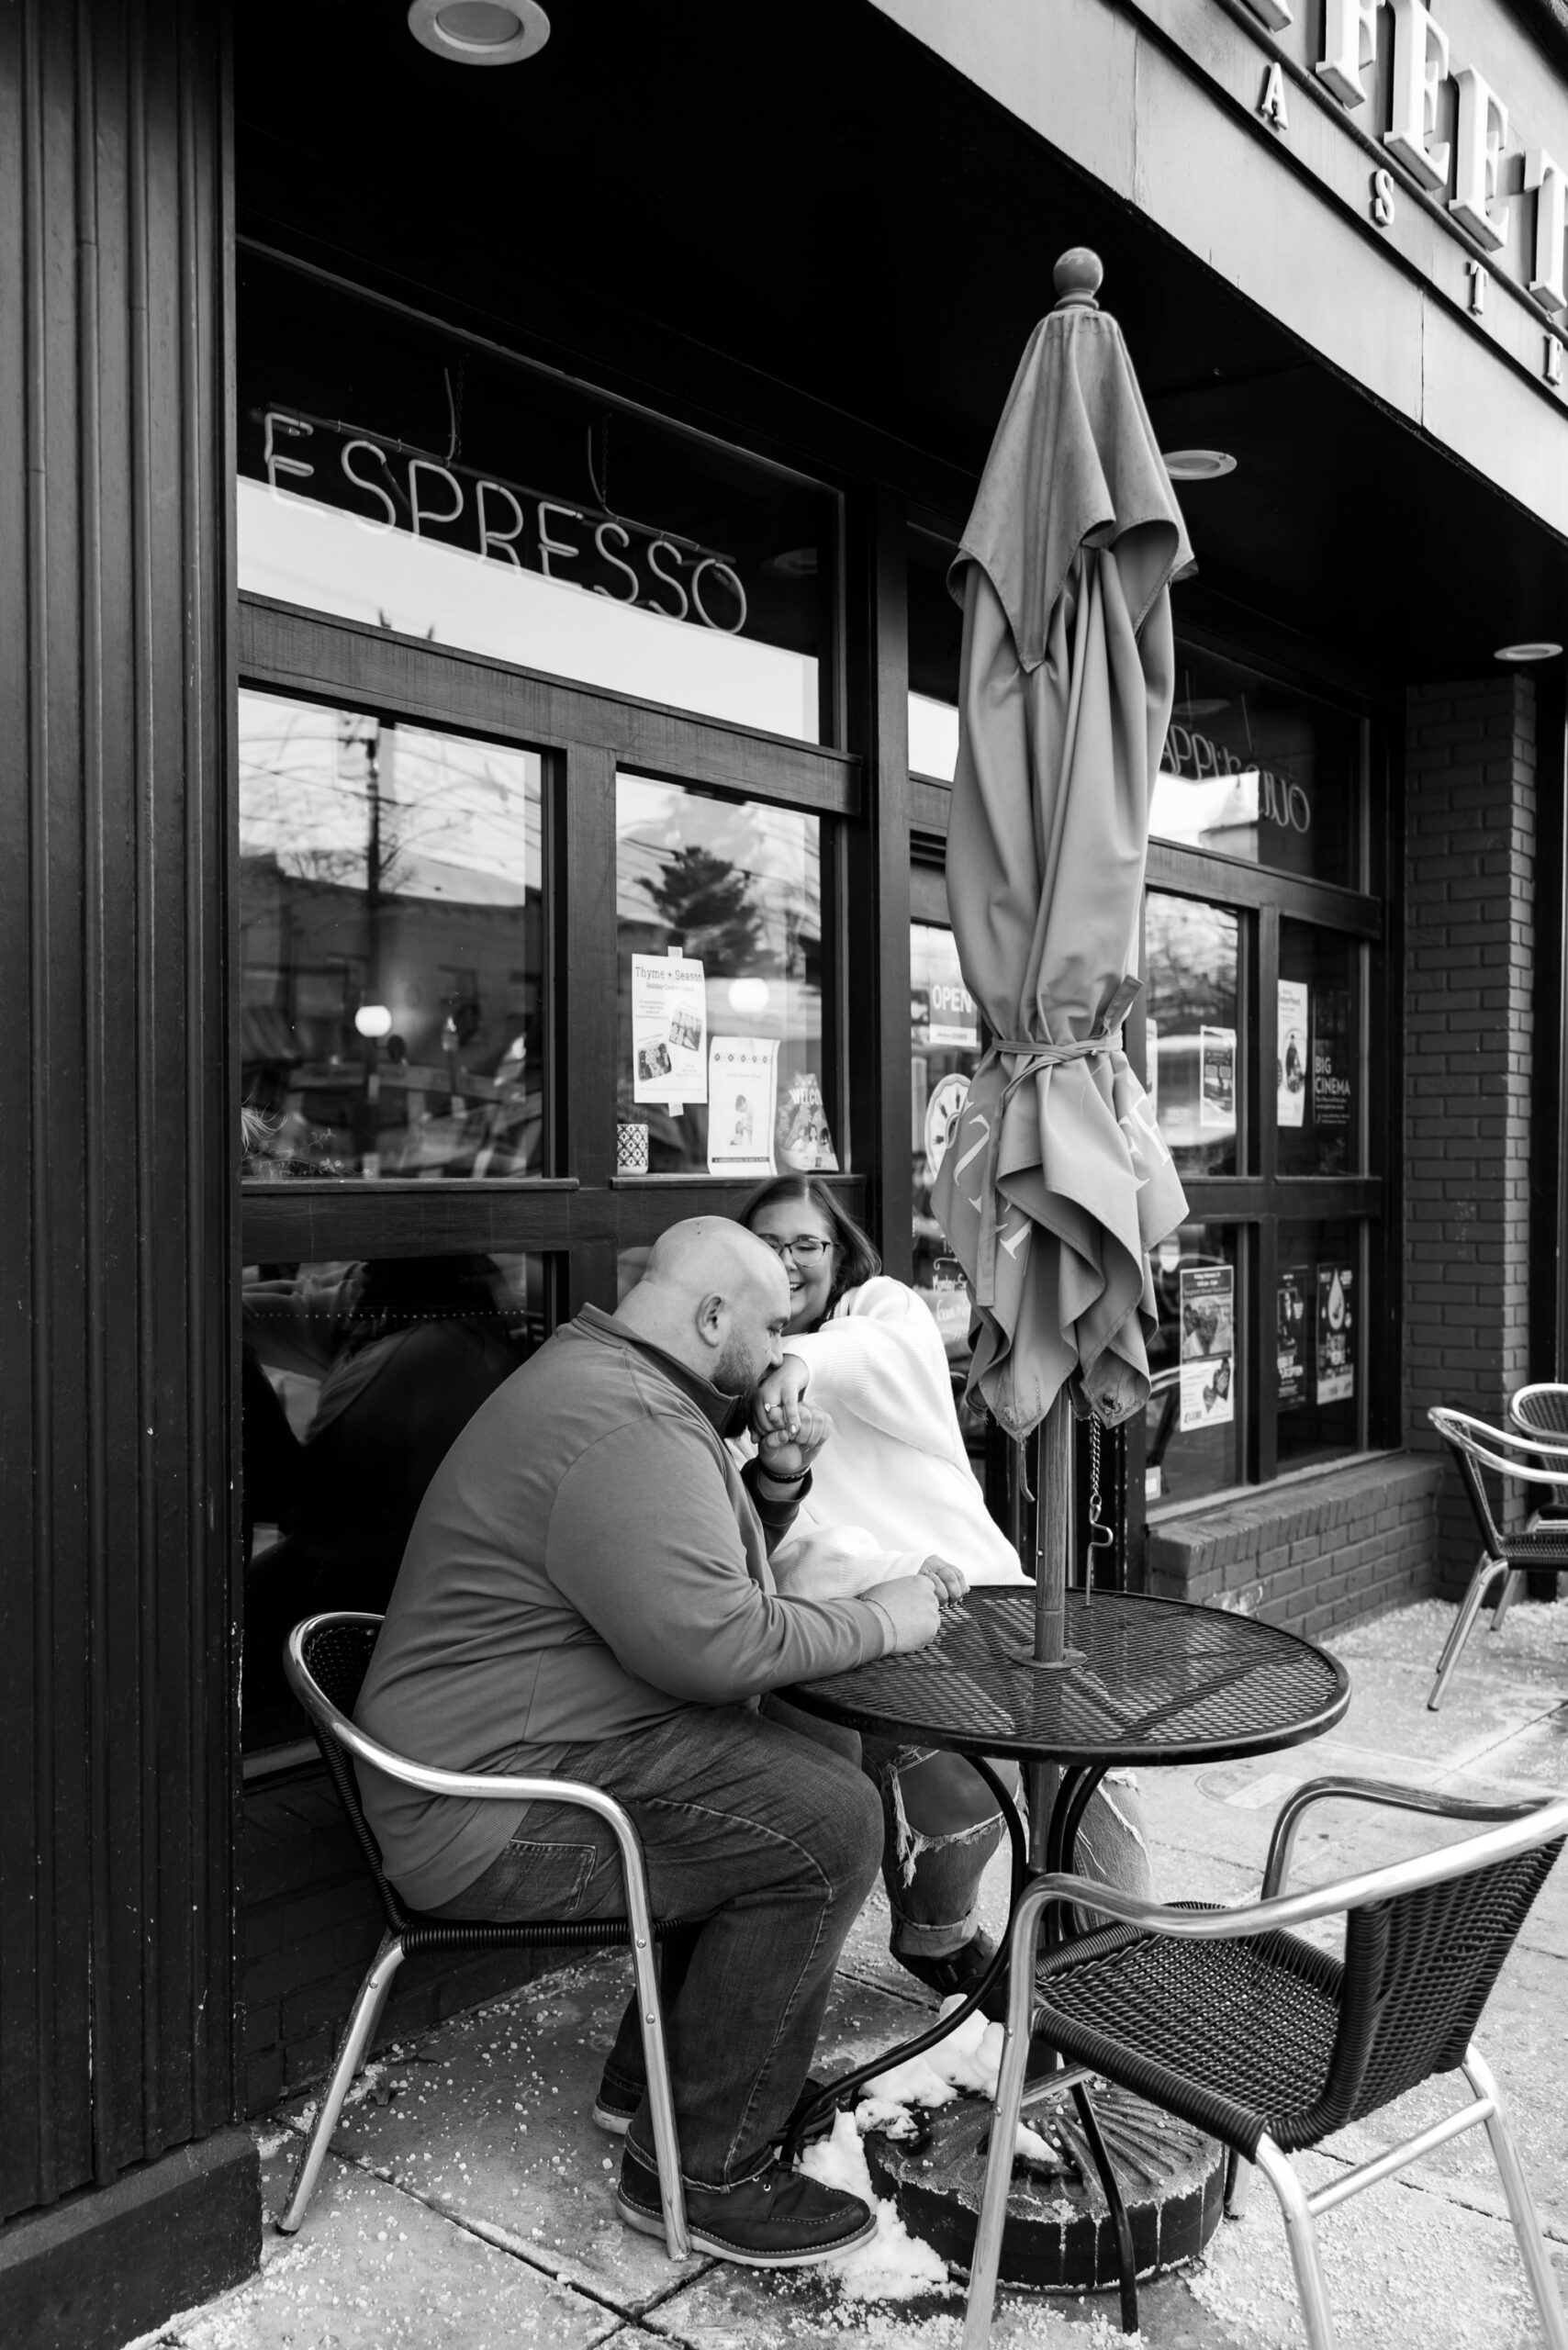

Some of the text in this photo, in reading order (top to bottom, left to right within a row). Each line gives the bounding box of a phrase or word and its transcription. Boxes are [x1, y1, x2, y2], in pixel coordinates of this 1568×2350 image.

[264, 411, 747, 635] ESPRESSO
[635, 966, 666, 981] Thyme
[675, 969, 703, 983] Season
[932, 984, 972, 1013] OPEN
[1316, 1056, 1332, 1075] BIG
[1315, 1077, 1351, 1097] CINEMA
